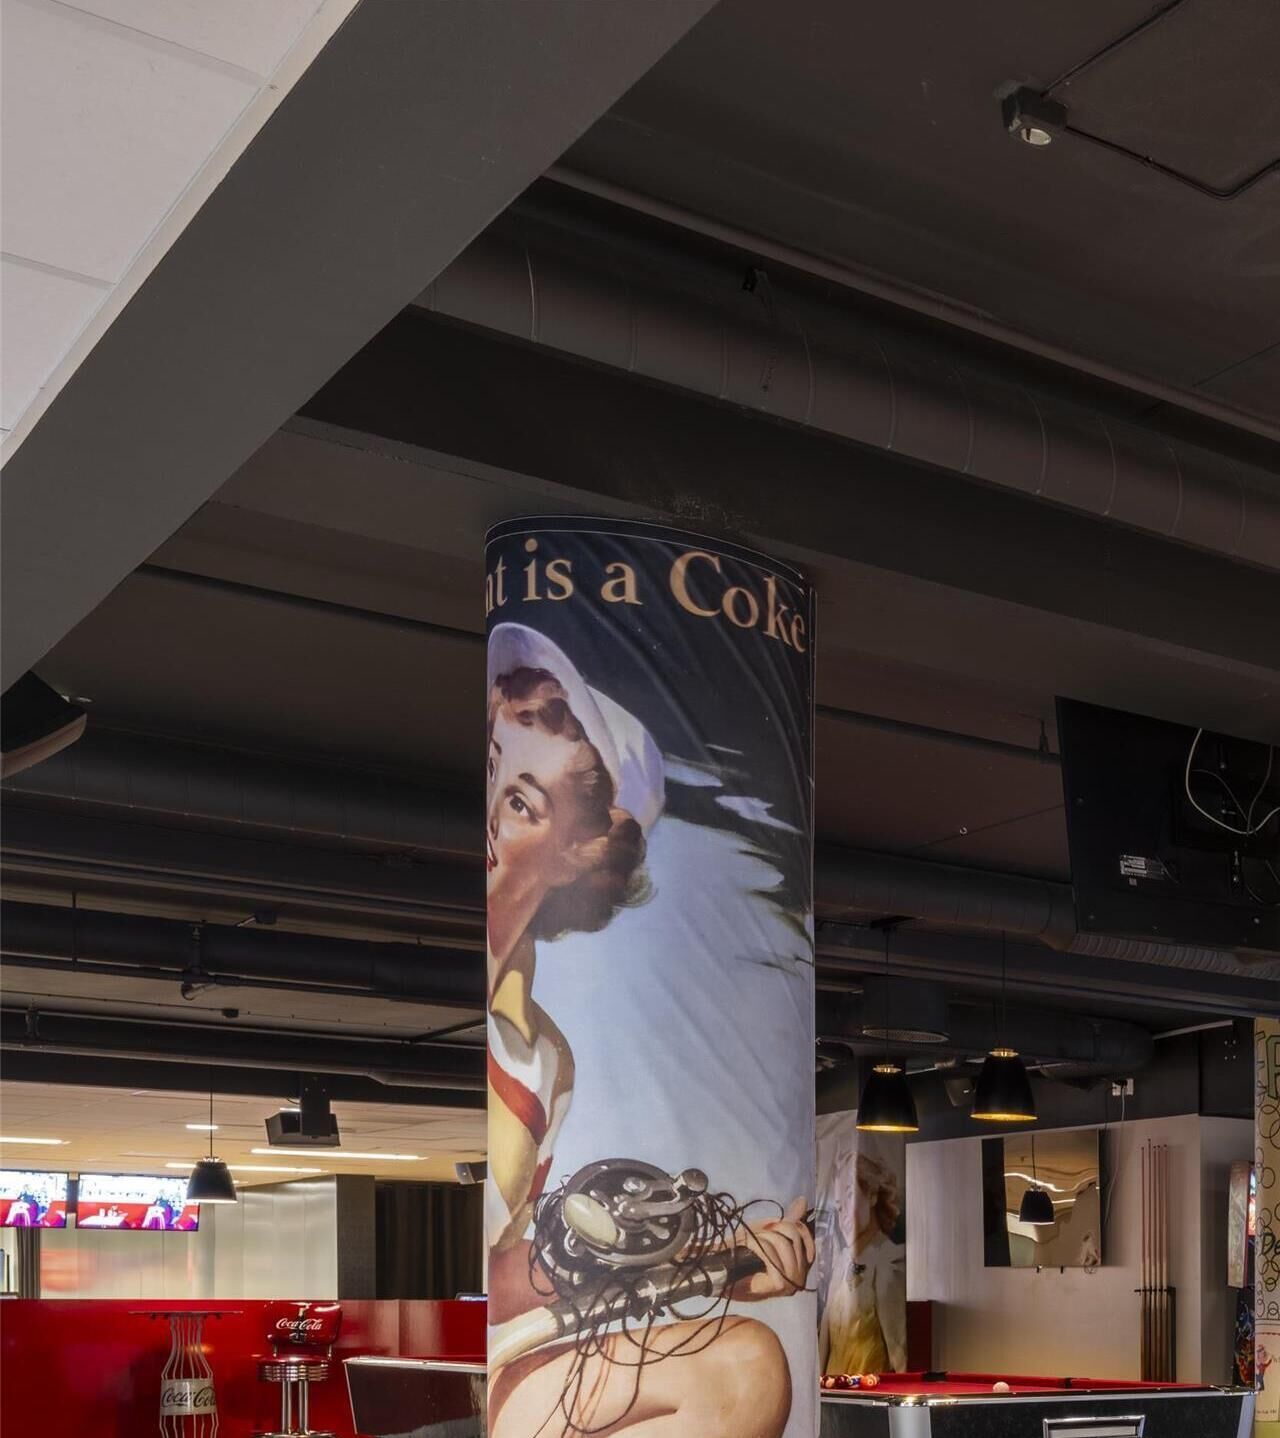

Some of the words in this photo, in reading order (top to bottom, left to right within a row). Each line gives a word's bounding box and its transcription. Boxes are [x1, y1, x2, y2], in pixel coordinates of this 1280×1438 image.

[523, 538, 574, 602] is
[600, 561, 643, 605] a
[669, 551, 807, 654] Coke
[275, 1317, 324, 1331] Coca-Cola
